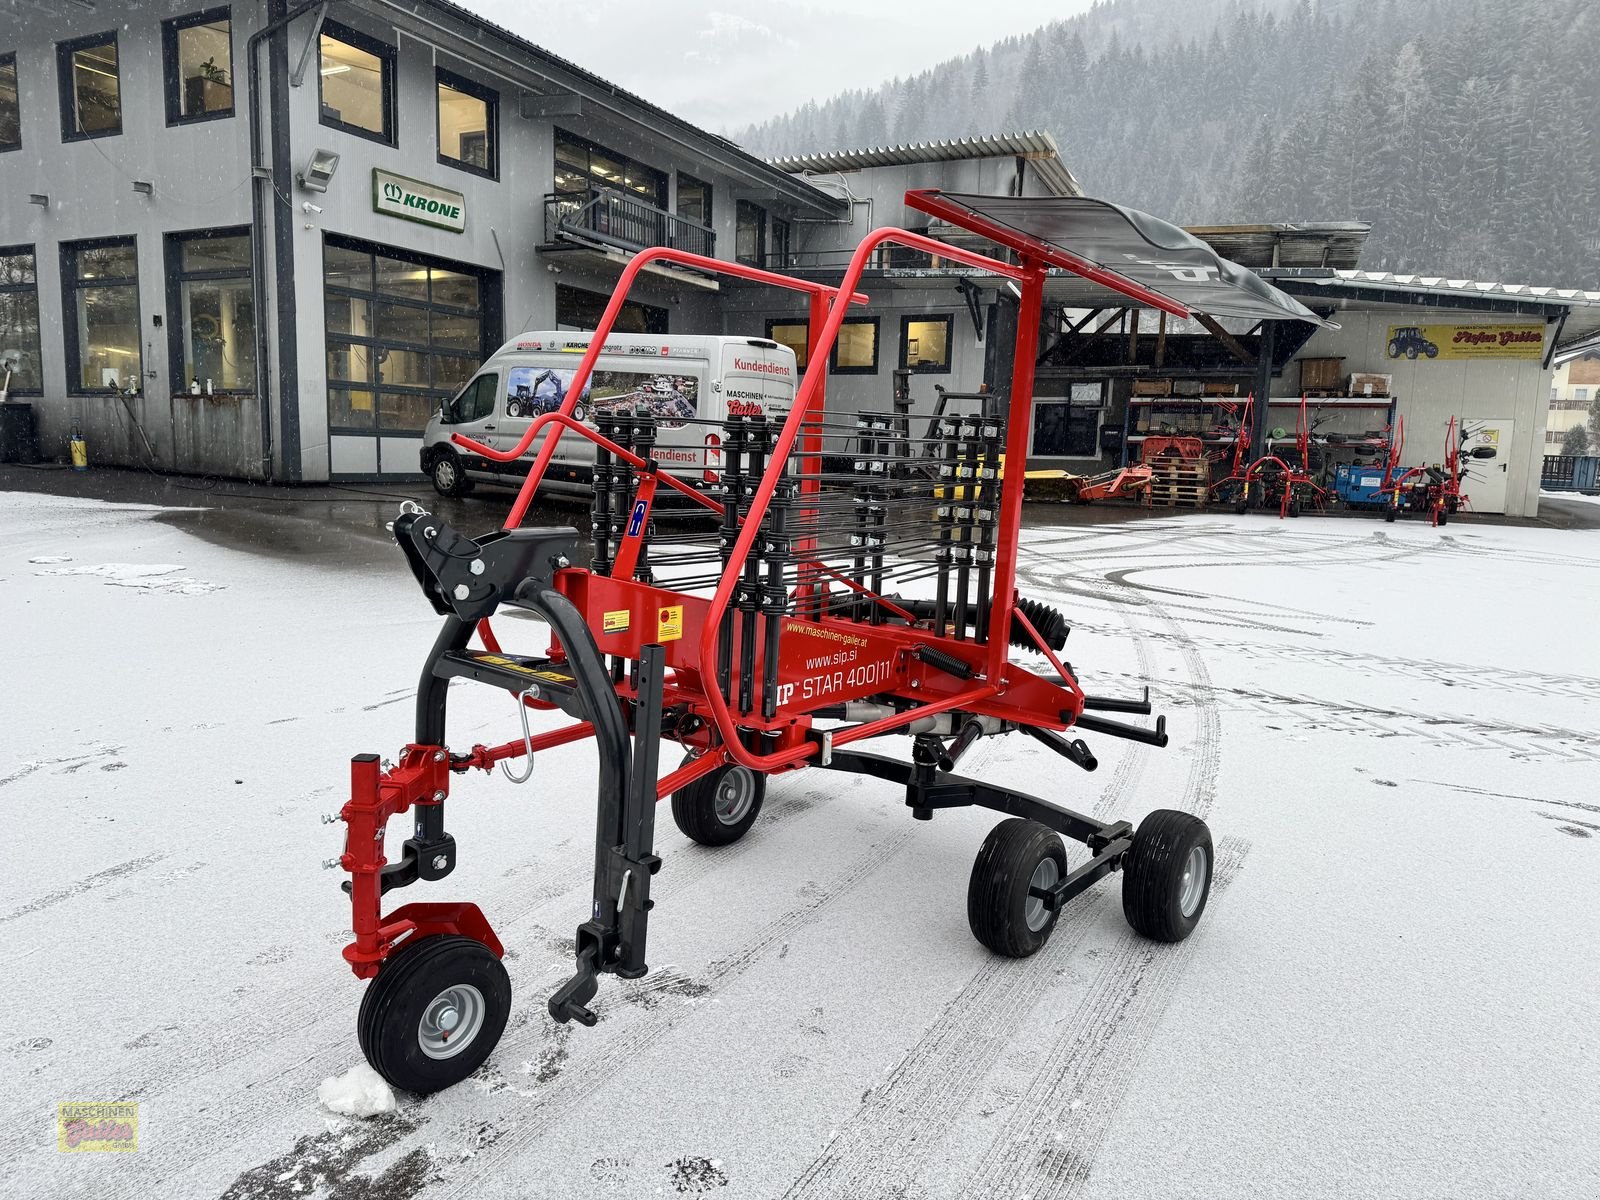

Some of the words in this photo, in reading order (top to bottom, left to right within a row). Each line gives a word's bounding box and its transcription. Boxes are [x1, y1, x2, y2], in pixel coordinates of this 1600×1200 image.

[403, 193, 460, 219] KRONE
[566, 341, 591, 349] KÄRCHE
[734, 358, 790, 376] Kundendienst
[726, 390, 763, 400] MASCHINEN
[786, 622, 868, 648] www.maschinen-gailer.at
[806, 646, 858, 670] www.sip.si
[802, 671, 843, 699] STAR
